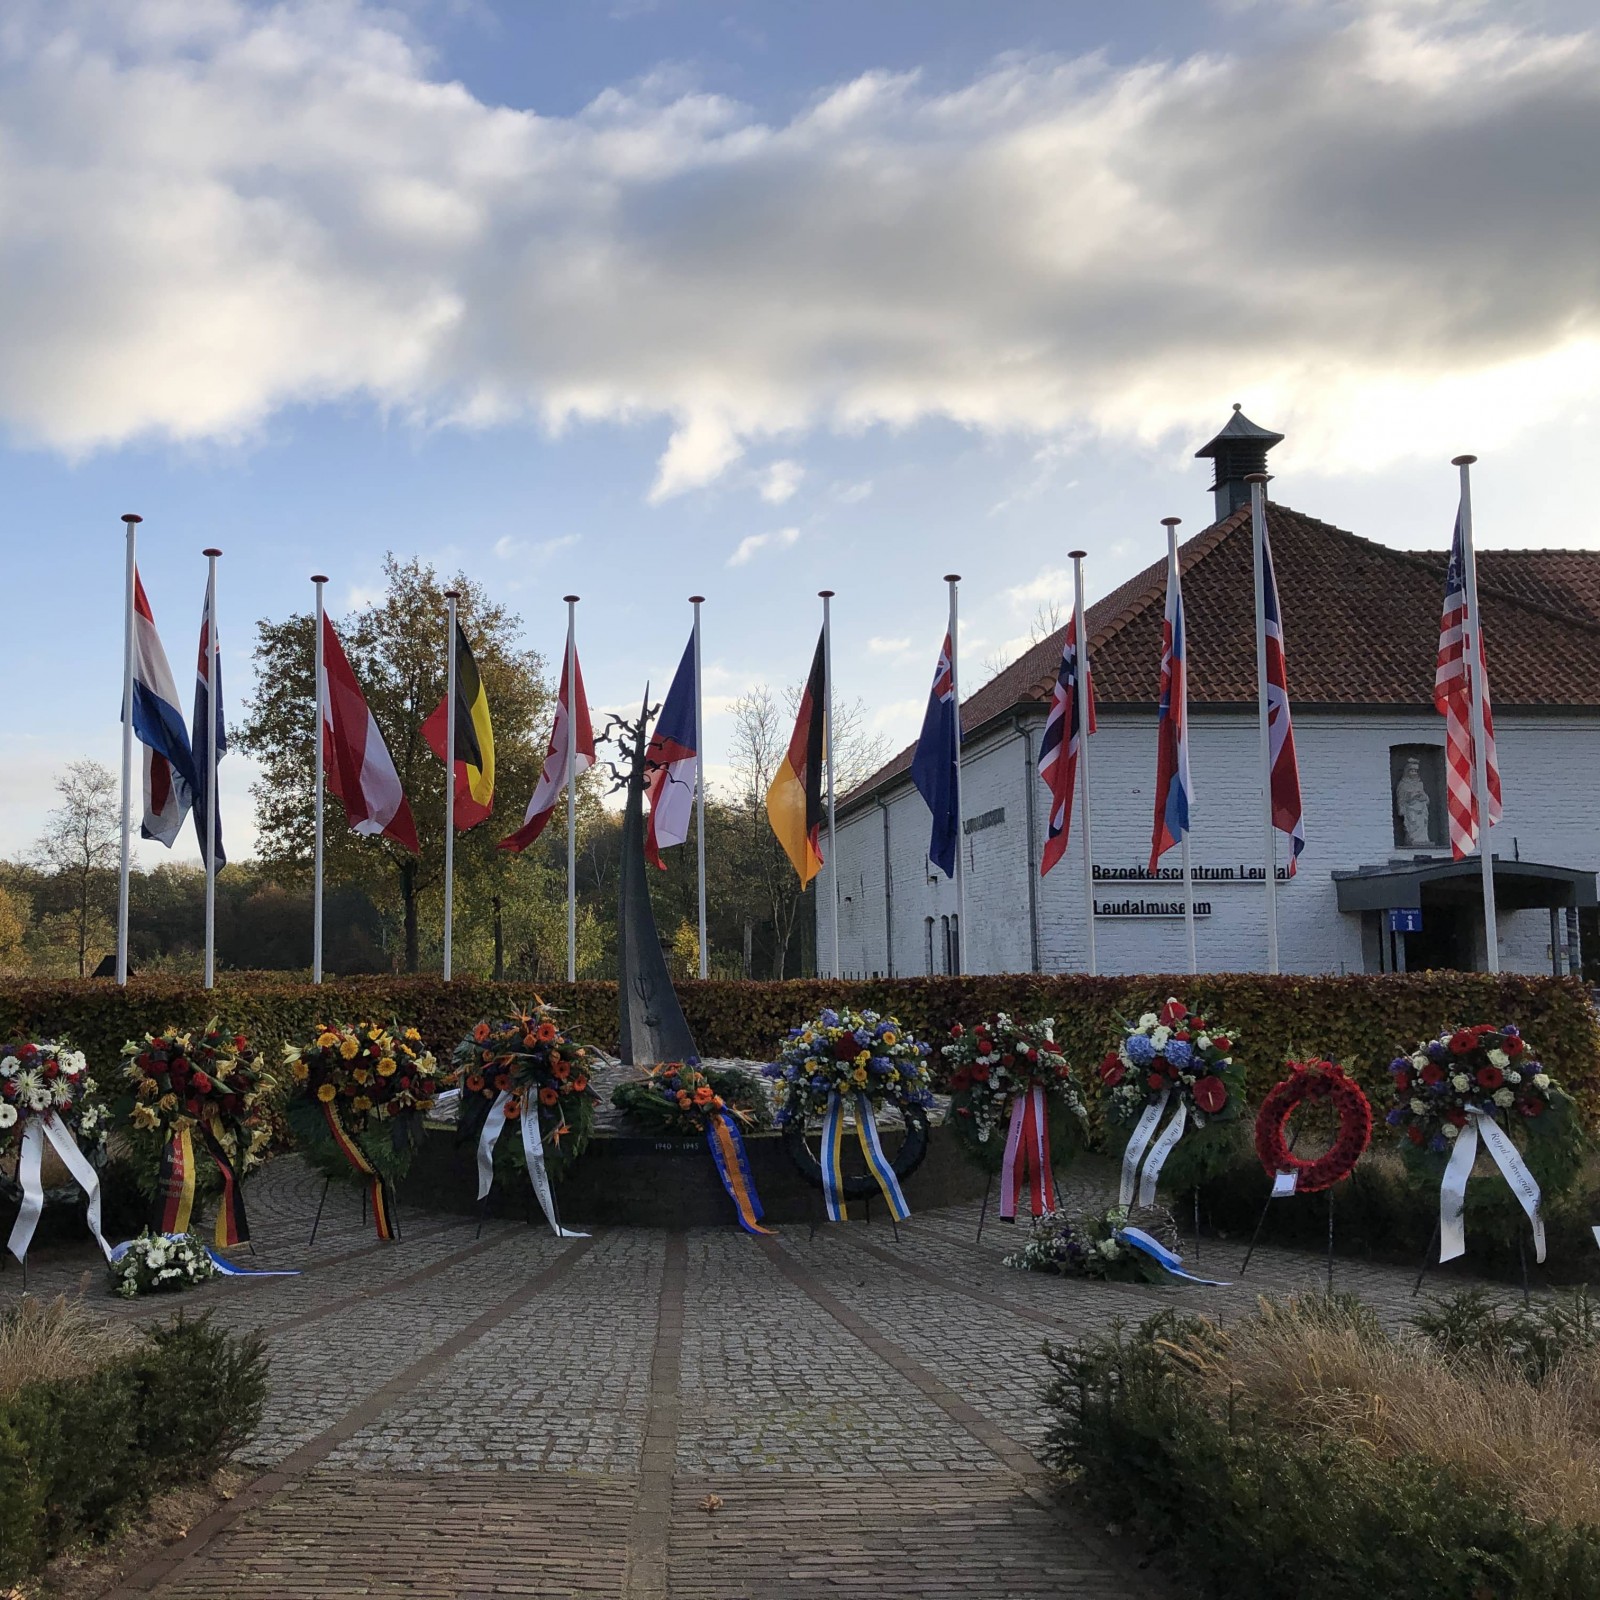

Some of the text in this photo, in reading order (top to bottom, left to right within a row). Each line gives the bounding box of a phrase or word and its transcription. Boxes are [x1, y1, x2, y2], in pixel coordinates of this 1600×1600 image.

[1093, 899, 1211, 915] Leudalmuseum
[655, 1142, 672, 1150] 1940
[682, 1142, 699, 1150] 1945
[1491, 1132, 1535, 1197] Royal Norwegian
